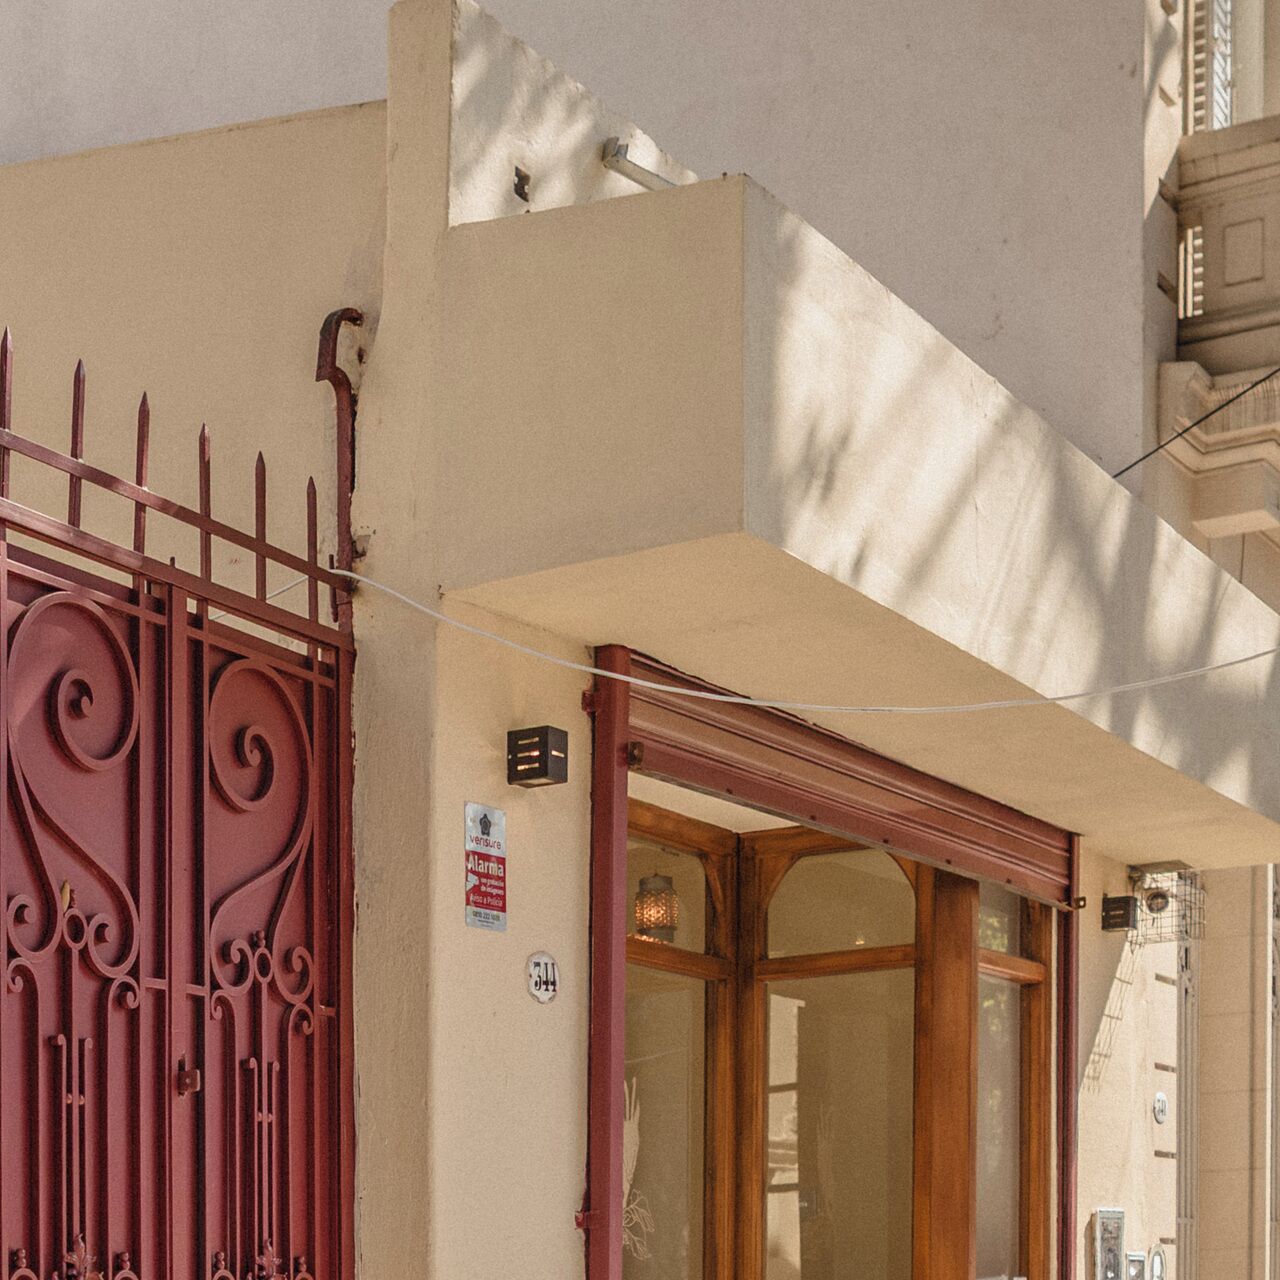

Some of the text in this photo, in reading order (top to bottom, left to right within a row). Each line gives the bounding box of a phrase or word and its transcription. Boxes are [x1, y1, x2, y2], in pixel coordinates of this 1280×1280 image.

[470, 835, 501, 850] verisure
[468, 853, 504, 877] Alarma
[533, 961, 557, 992] 344
